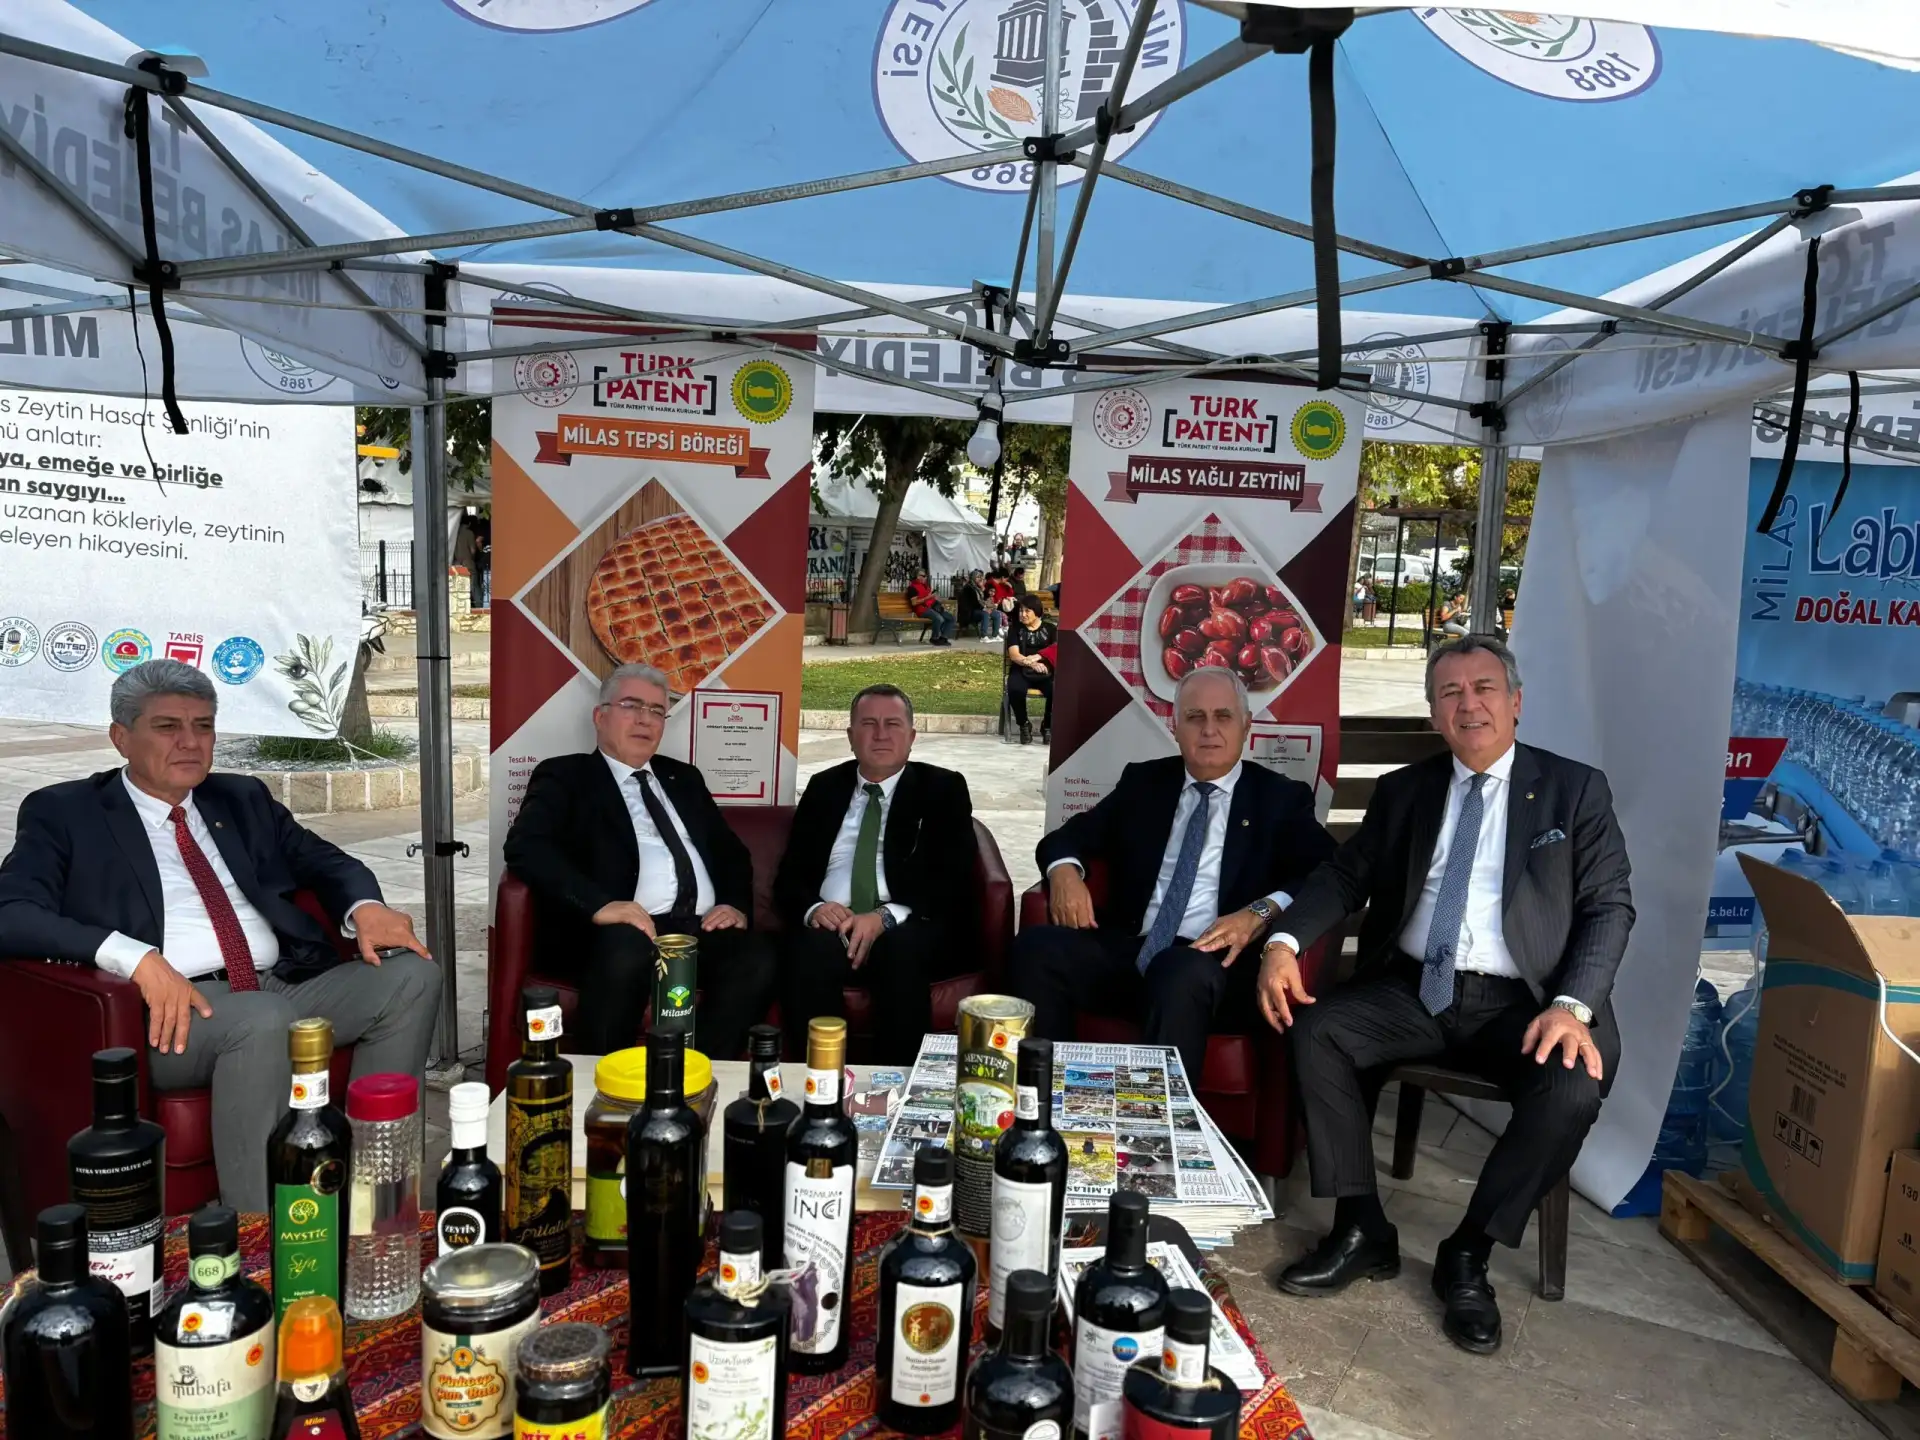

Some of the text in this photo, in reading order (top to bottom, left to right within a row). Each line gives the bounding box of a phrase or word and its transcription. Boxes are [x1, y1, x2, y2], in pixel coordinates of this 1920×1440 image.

[620, 352, 696, 380] TÜRK
[606, 378, 709, 406] PATENT
[18, 396, 83, 421] Zeytin
[90, 404, 155, 428] Hasat
[1189, 395, 1259, 420] TÜRK
[26, 426, 102, 449] anlatır:
[563, 422, 744, 457] MİLAS TEPSİ BÖREĞİ
[1175, 419, 1269, 443] PATENT
[37, 456, 115, 478] emeğe
[120, 463, 147, 478] ve
[153, 463, 224, 489] birliğe
[1130, 463, 1301, 492] MİLAS YAĞLI ZEYTİNİ
[4, 504, 285, 544] uzanan kökleriyle, zeytinin
[0, 527, 189, 561] eleyen hikayesini.
[1751, 494, 1799, 621] MİLAS
[1794, 590, 1920, 626] DOĞAL KA
[508, 756, 526, 764] Tescil
[95, 1167, 120, 1175] VIRGIN
[121, 1163, 142, 1173] OLIVE
[197, 1266, 219, 1278] 668
